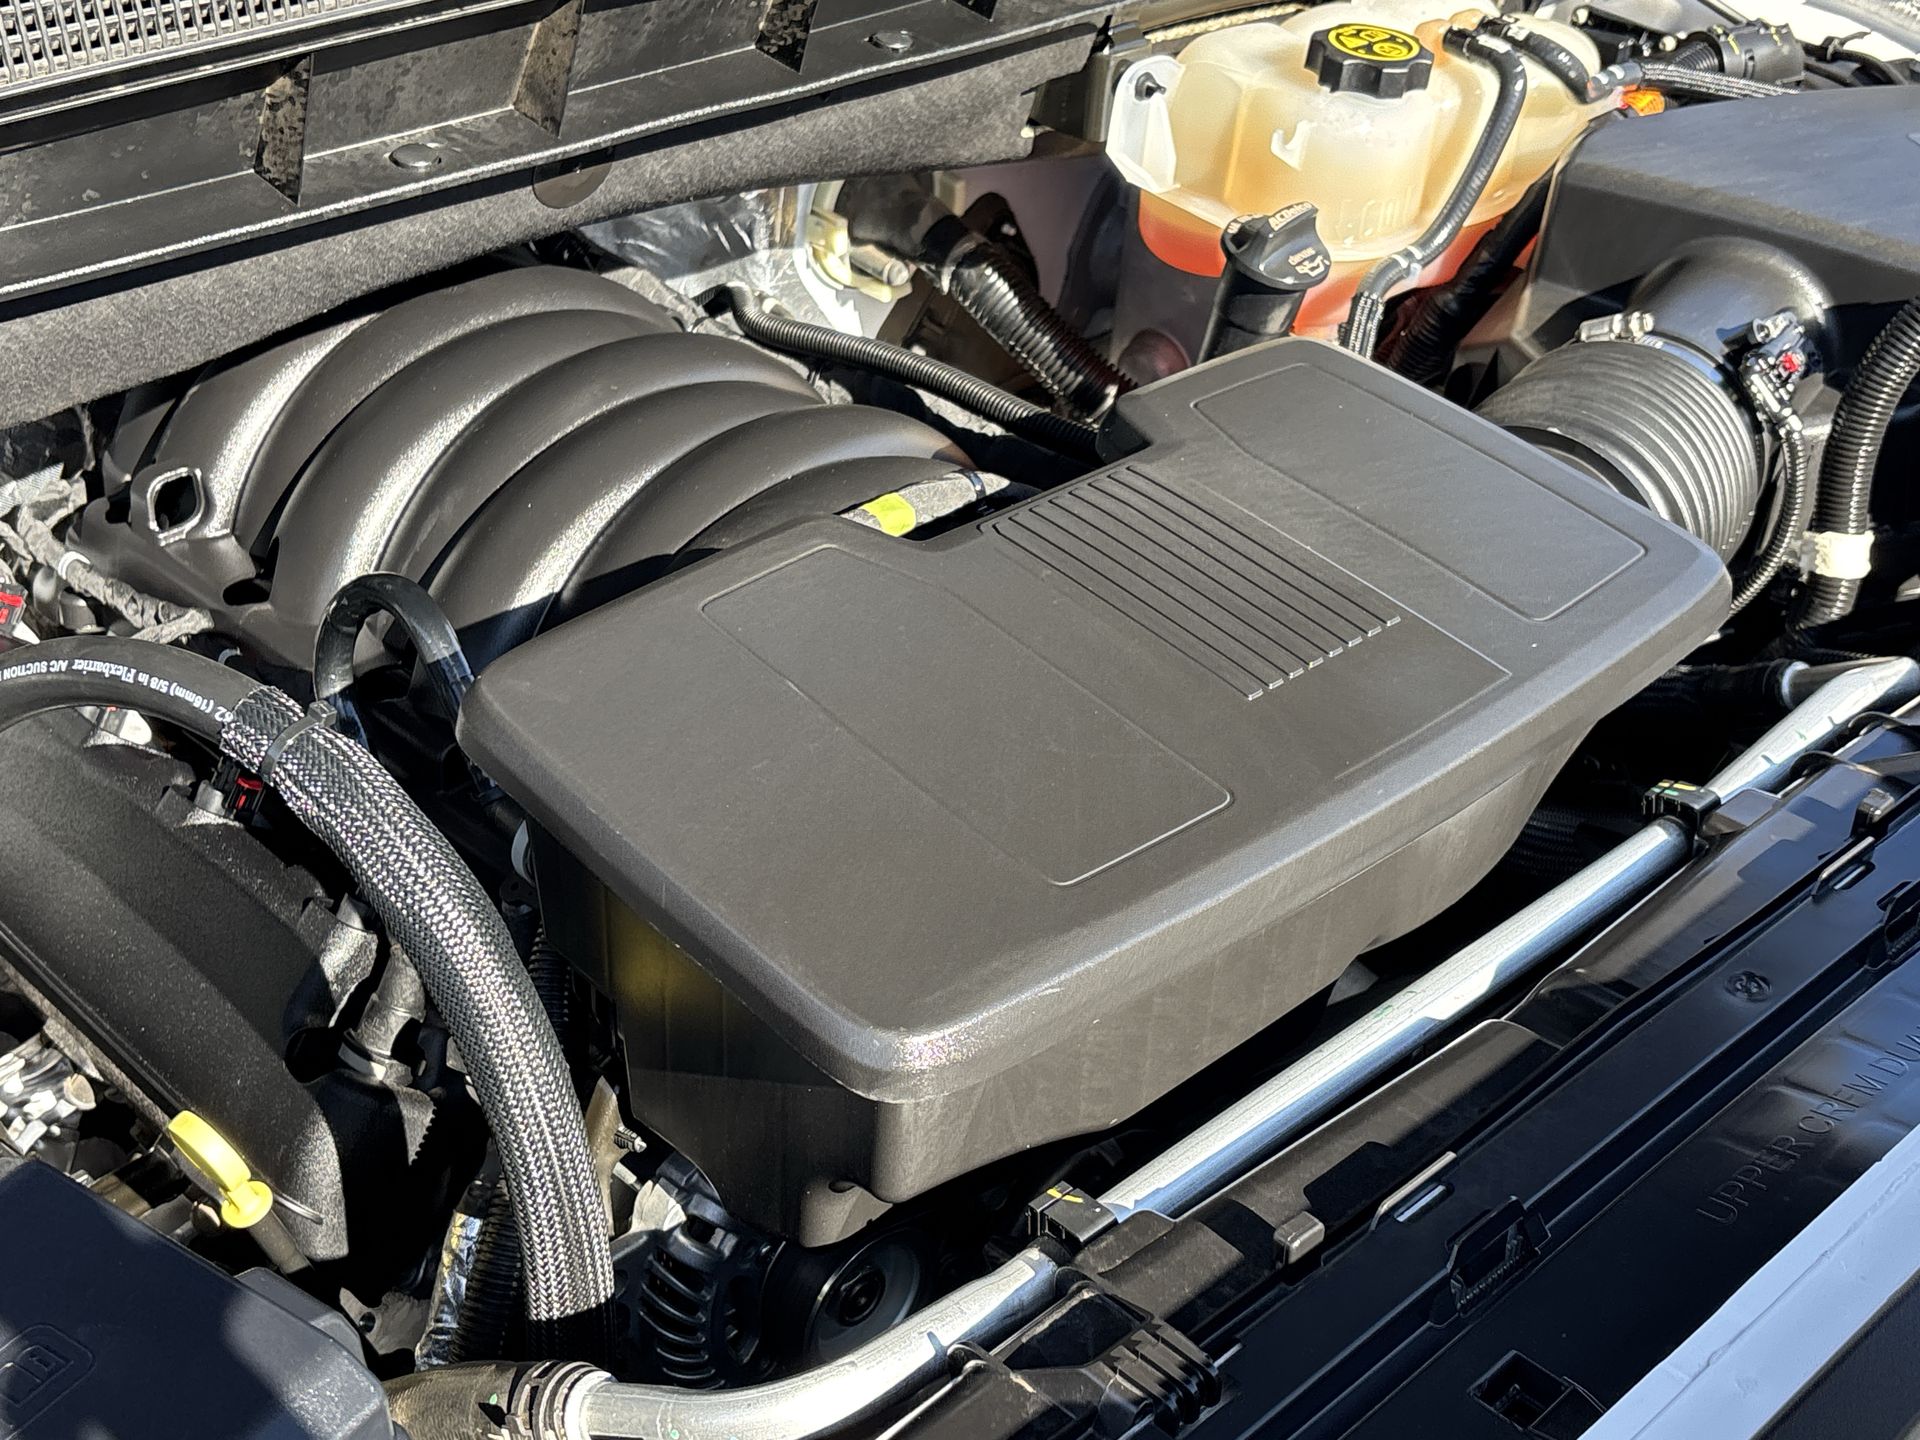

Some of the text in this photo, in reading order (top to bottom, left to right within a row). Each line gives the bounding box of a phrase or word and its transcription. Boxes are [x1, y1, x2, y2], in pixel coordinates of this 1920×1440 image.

[1268, 202, 1313, 231] ACDelco
[3, 660, 48, 681] SUCTION
[49, 659, 68, 672] A/C
[72, 658, 137, 683] Flexbarrier
[150, 676, 168, 694] 5/8
[169, 682, 214, 714] (16mm)
[1696, 1134, 1815, 1224] UPPER
